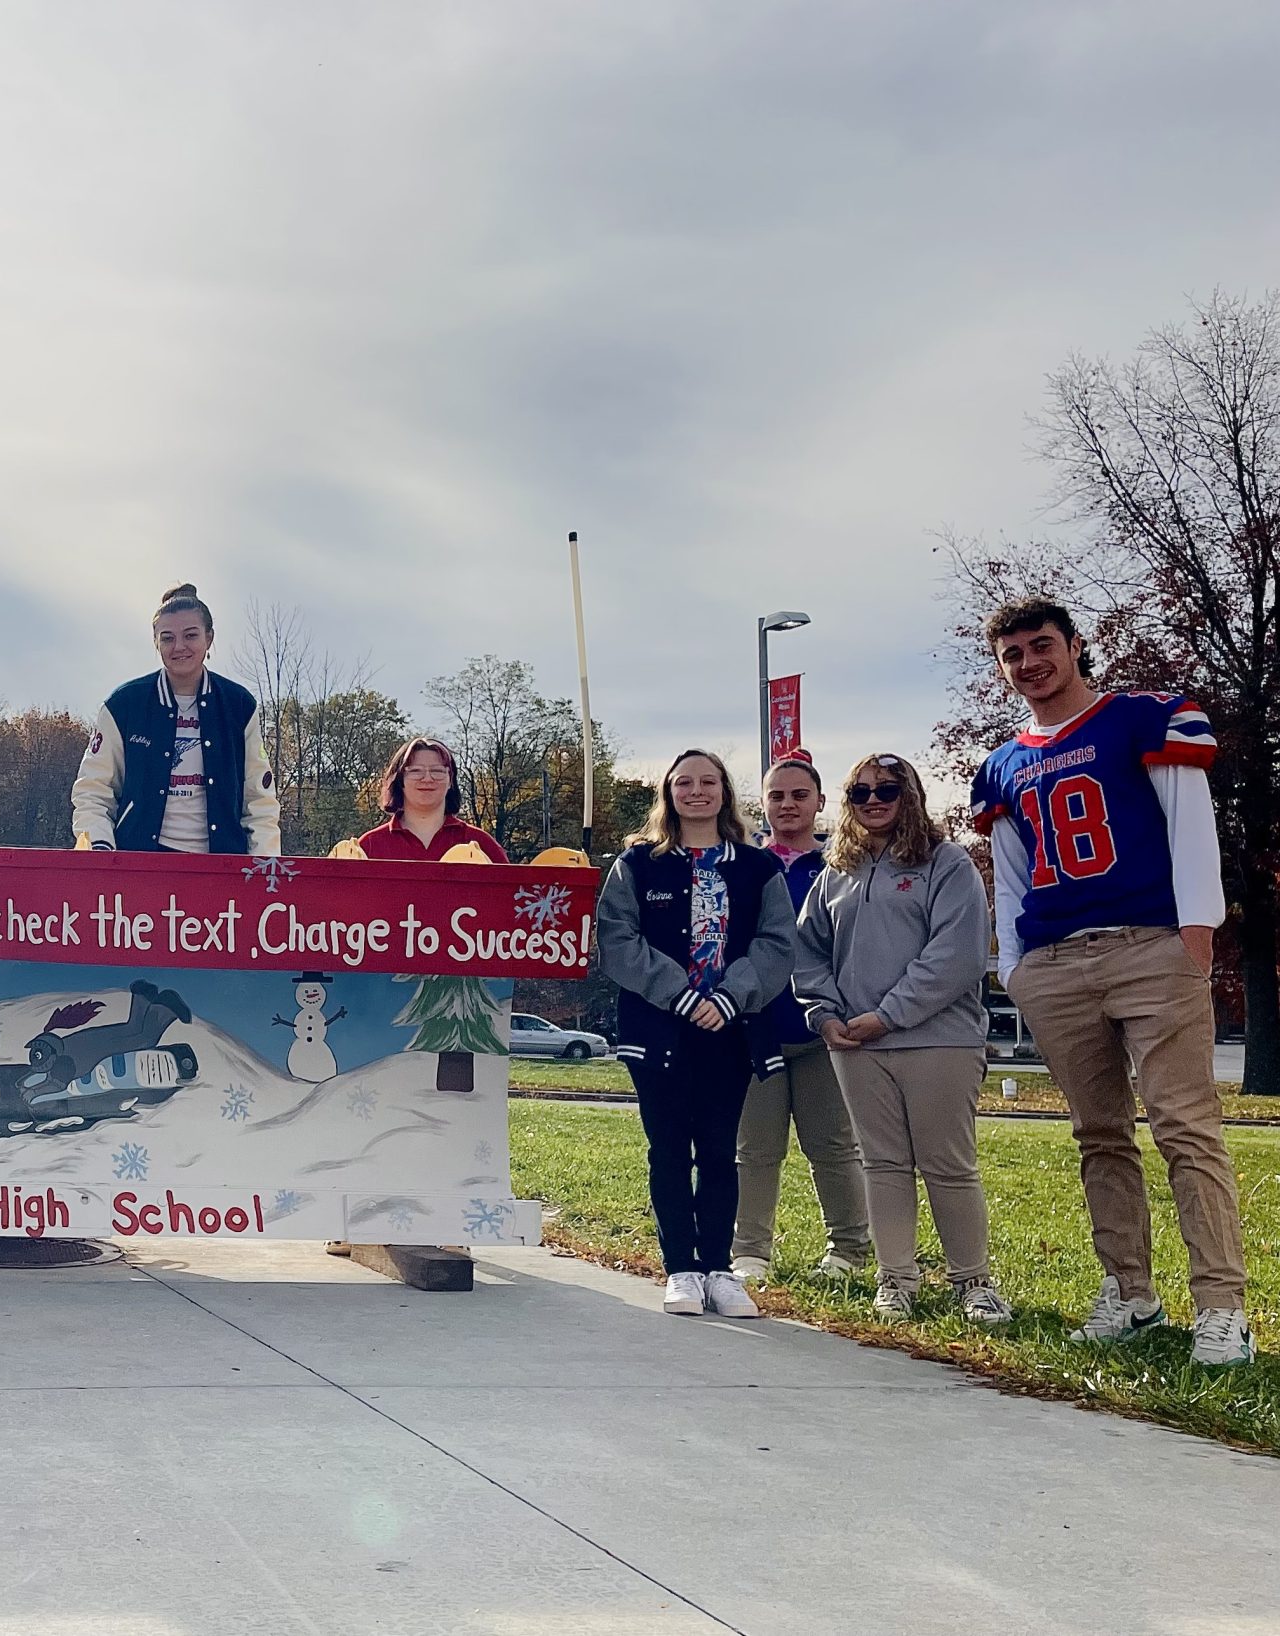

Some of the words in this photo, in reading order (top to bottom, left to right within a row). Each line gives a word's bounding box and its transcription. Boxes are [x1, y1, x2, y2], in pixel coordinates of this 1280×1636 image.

[1014, 745, 1096, 786] CHARGERS
[1020, 773, 1118, 890] 18
[90, 894, 153, 949] the
[400, 904, 439, 957] to
[448, 908, 591, 966] Success!
[113, 1192, 263, 1235] School
